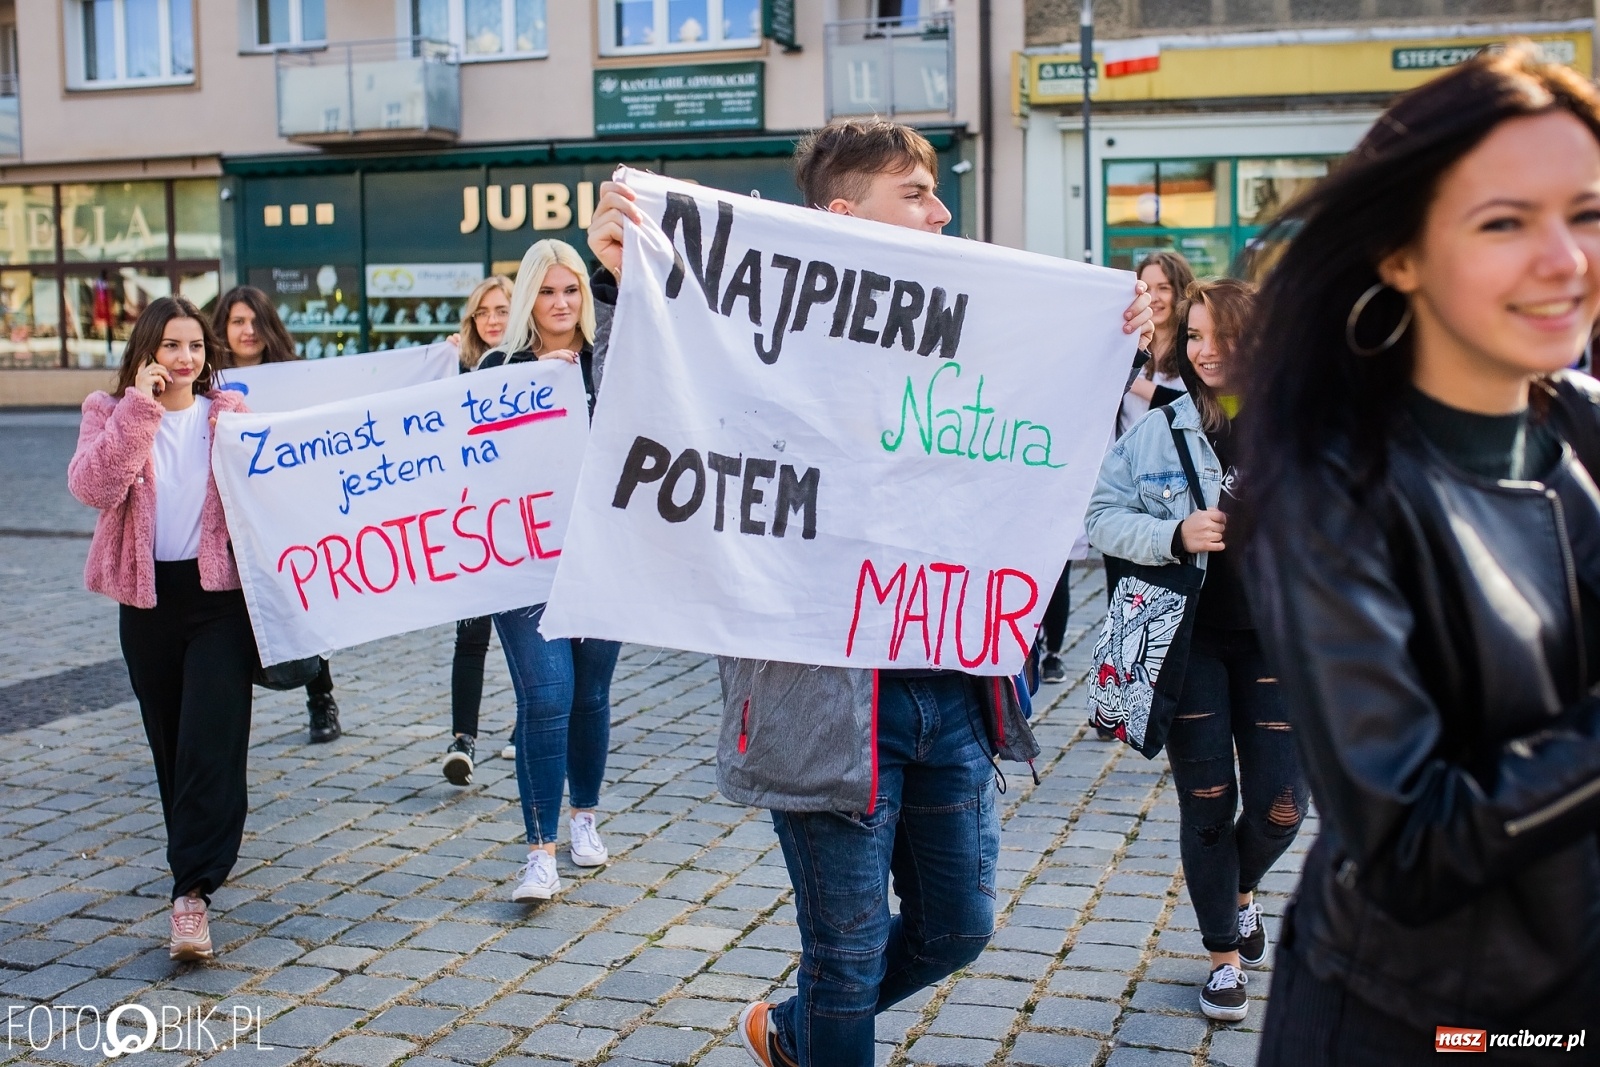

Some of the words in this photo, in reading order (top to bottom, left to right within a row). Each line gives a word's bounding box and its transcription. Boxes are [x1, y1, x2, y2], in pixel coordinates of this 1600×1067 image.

[1398, 48, 1483, 67] STEFCZY
[460, 181, 595, 234] JUBI
[660, 191, 969, 365] NAJPIERW
[240, 409, 386, 478] Zamiast
[403, 410, 446, 436] na
[460, 381, 555, 424] teście
[880, 362, 1069, 469] Natura
[339, 453, 446, 515] jestem
[460, 438, 500, 468] na
[611, 435, 821, 540] POTEM
[277, 487, 562, 612] PROTEŚCIE
[846, 558, 1040, 668] MATUR
